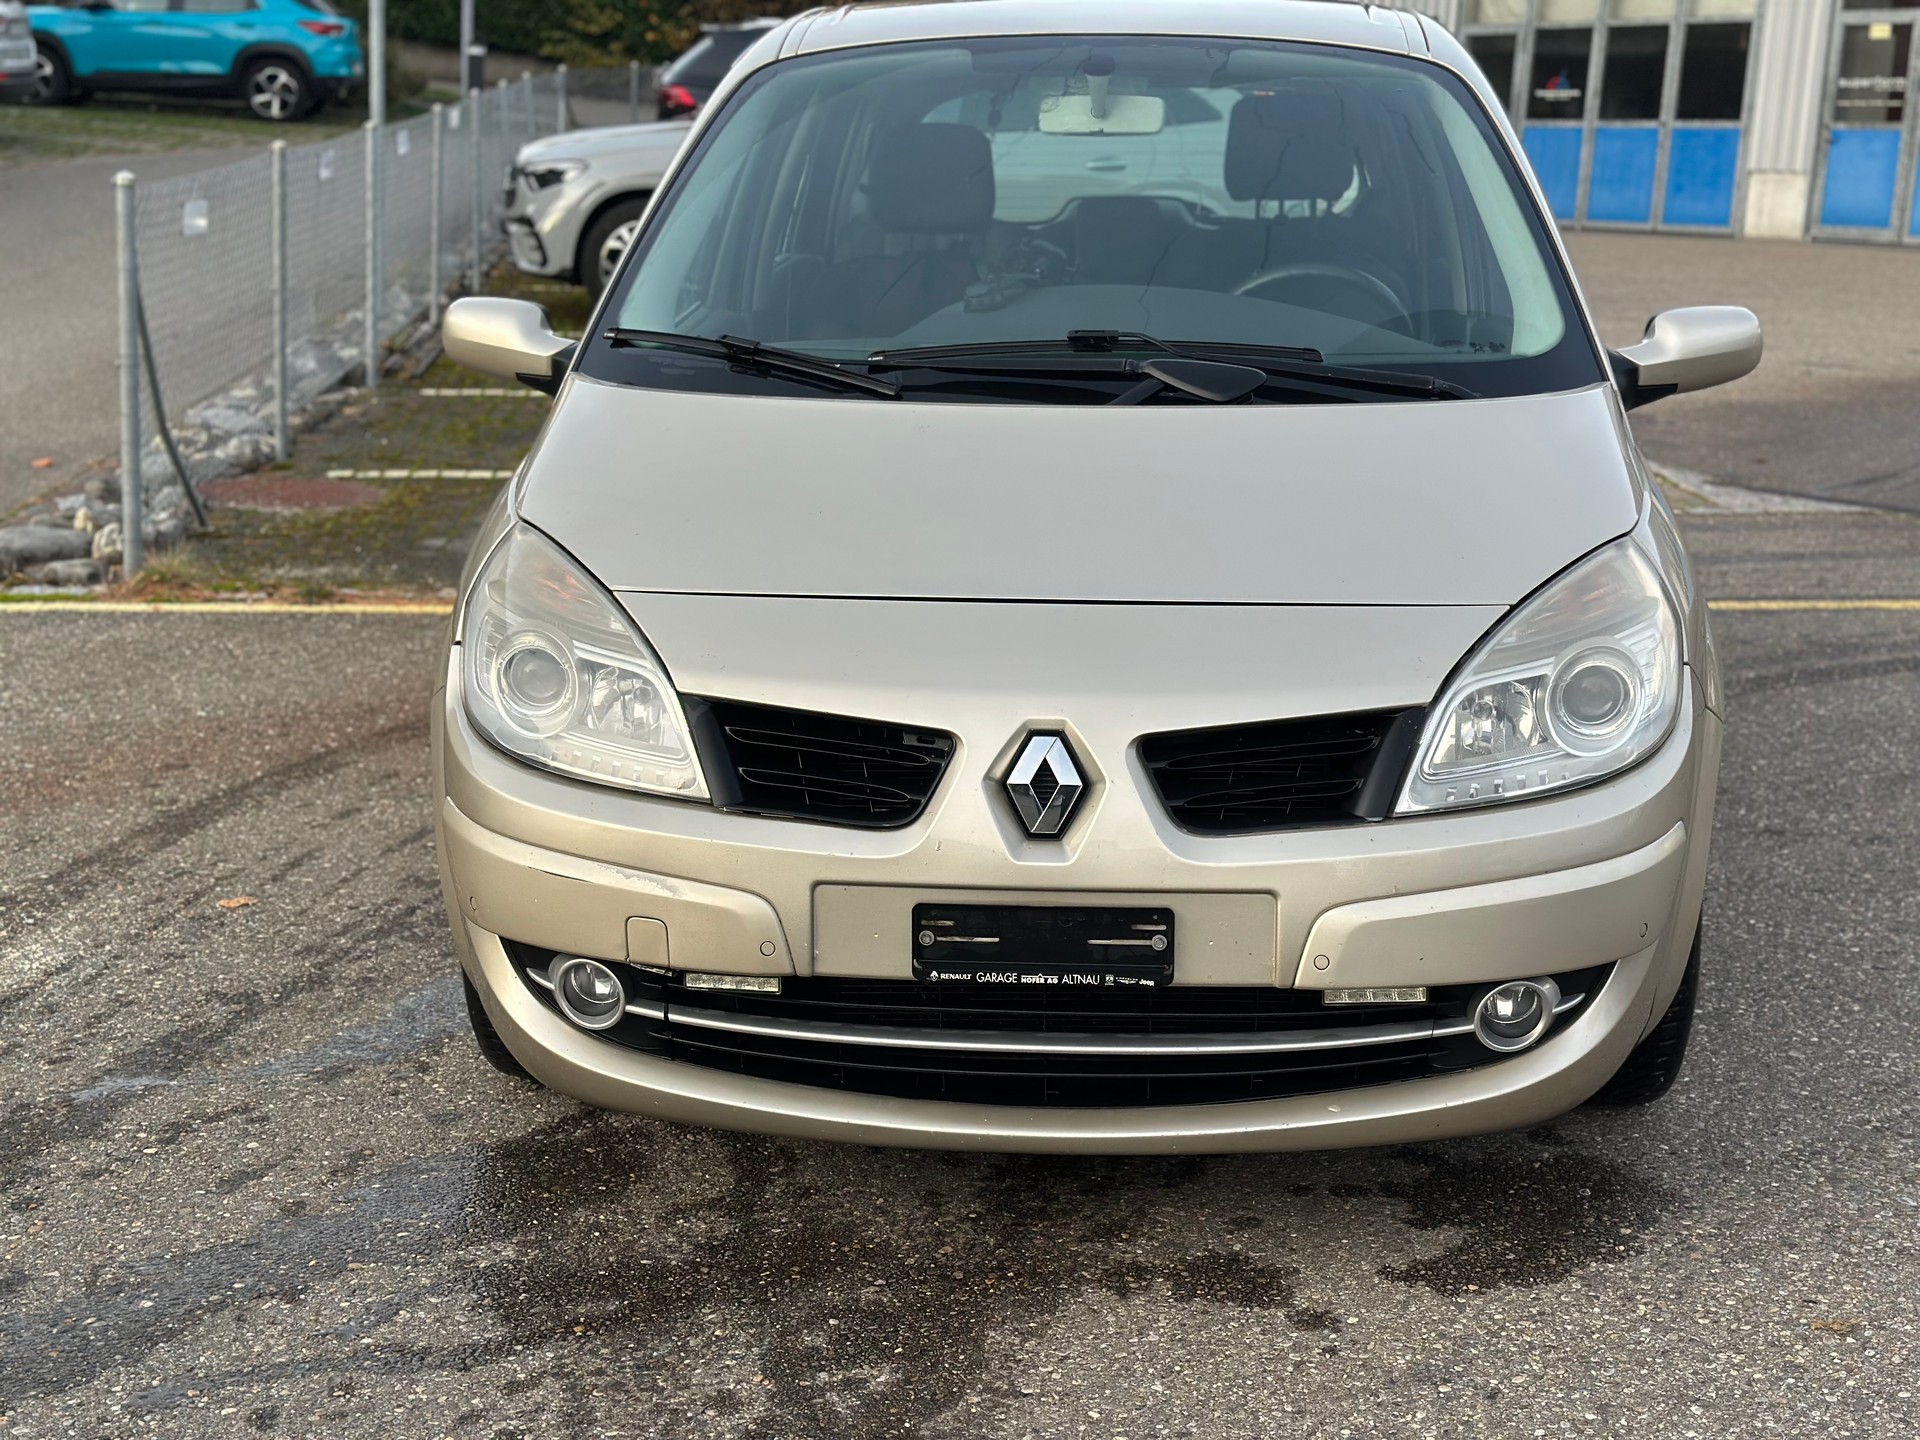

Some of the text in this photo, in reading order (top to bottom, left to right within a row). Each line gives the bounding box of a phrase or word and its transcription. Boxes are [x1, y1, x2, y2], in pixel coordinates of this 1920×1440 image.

[976, 972, 1018, 983] GARAGE
[1062, 974, 1100, 985] ALTNAU
[1139, 979, 1155, 987] Jeep
